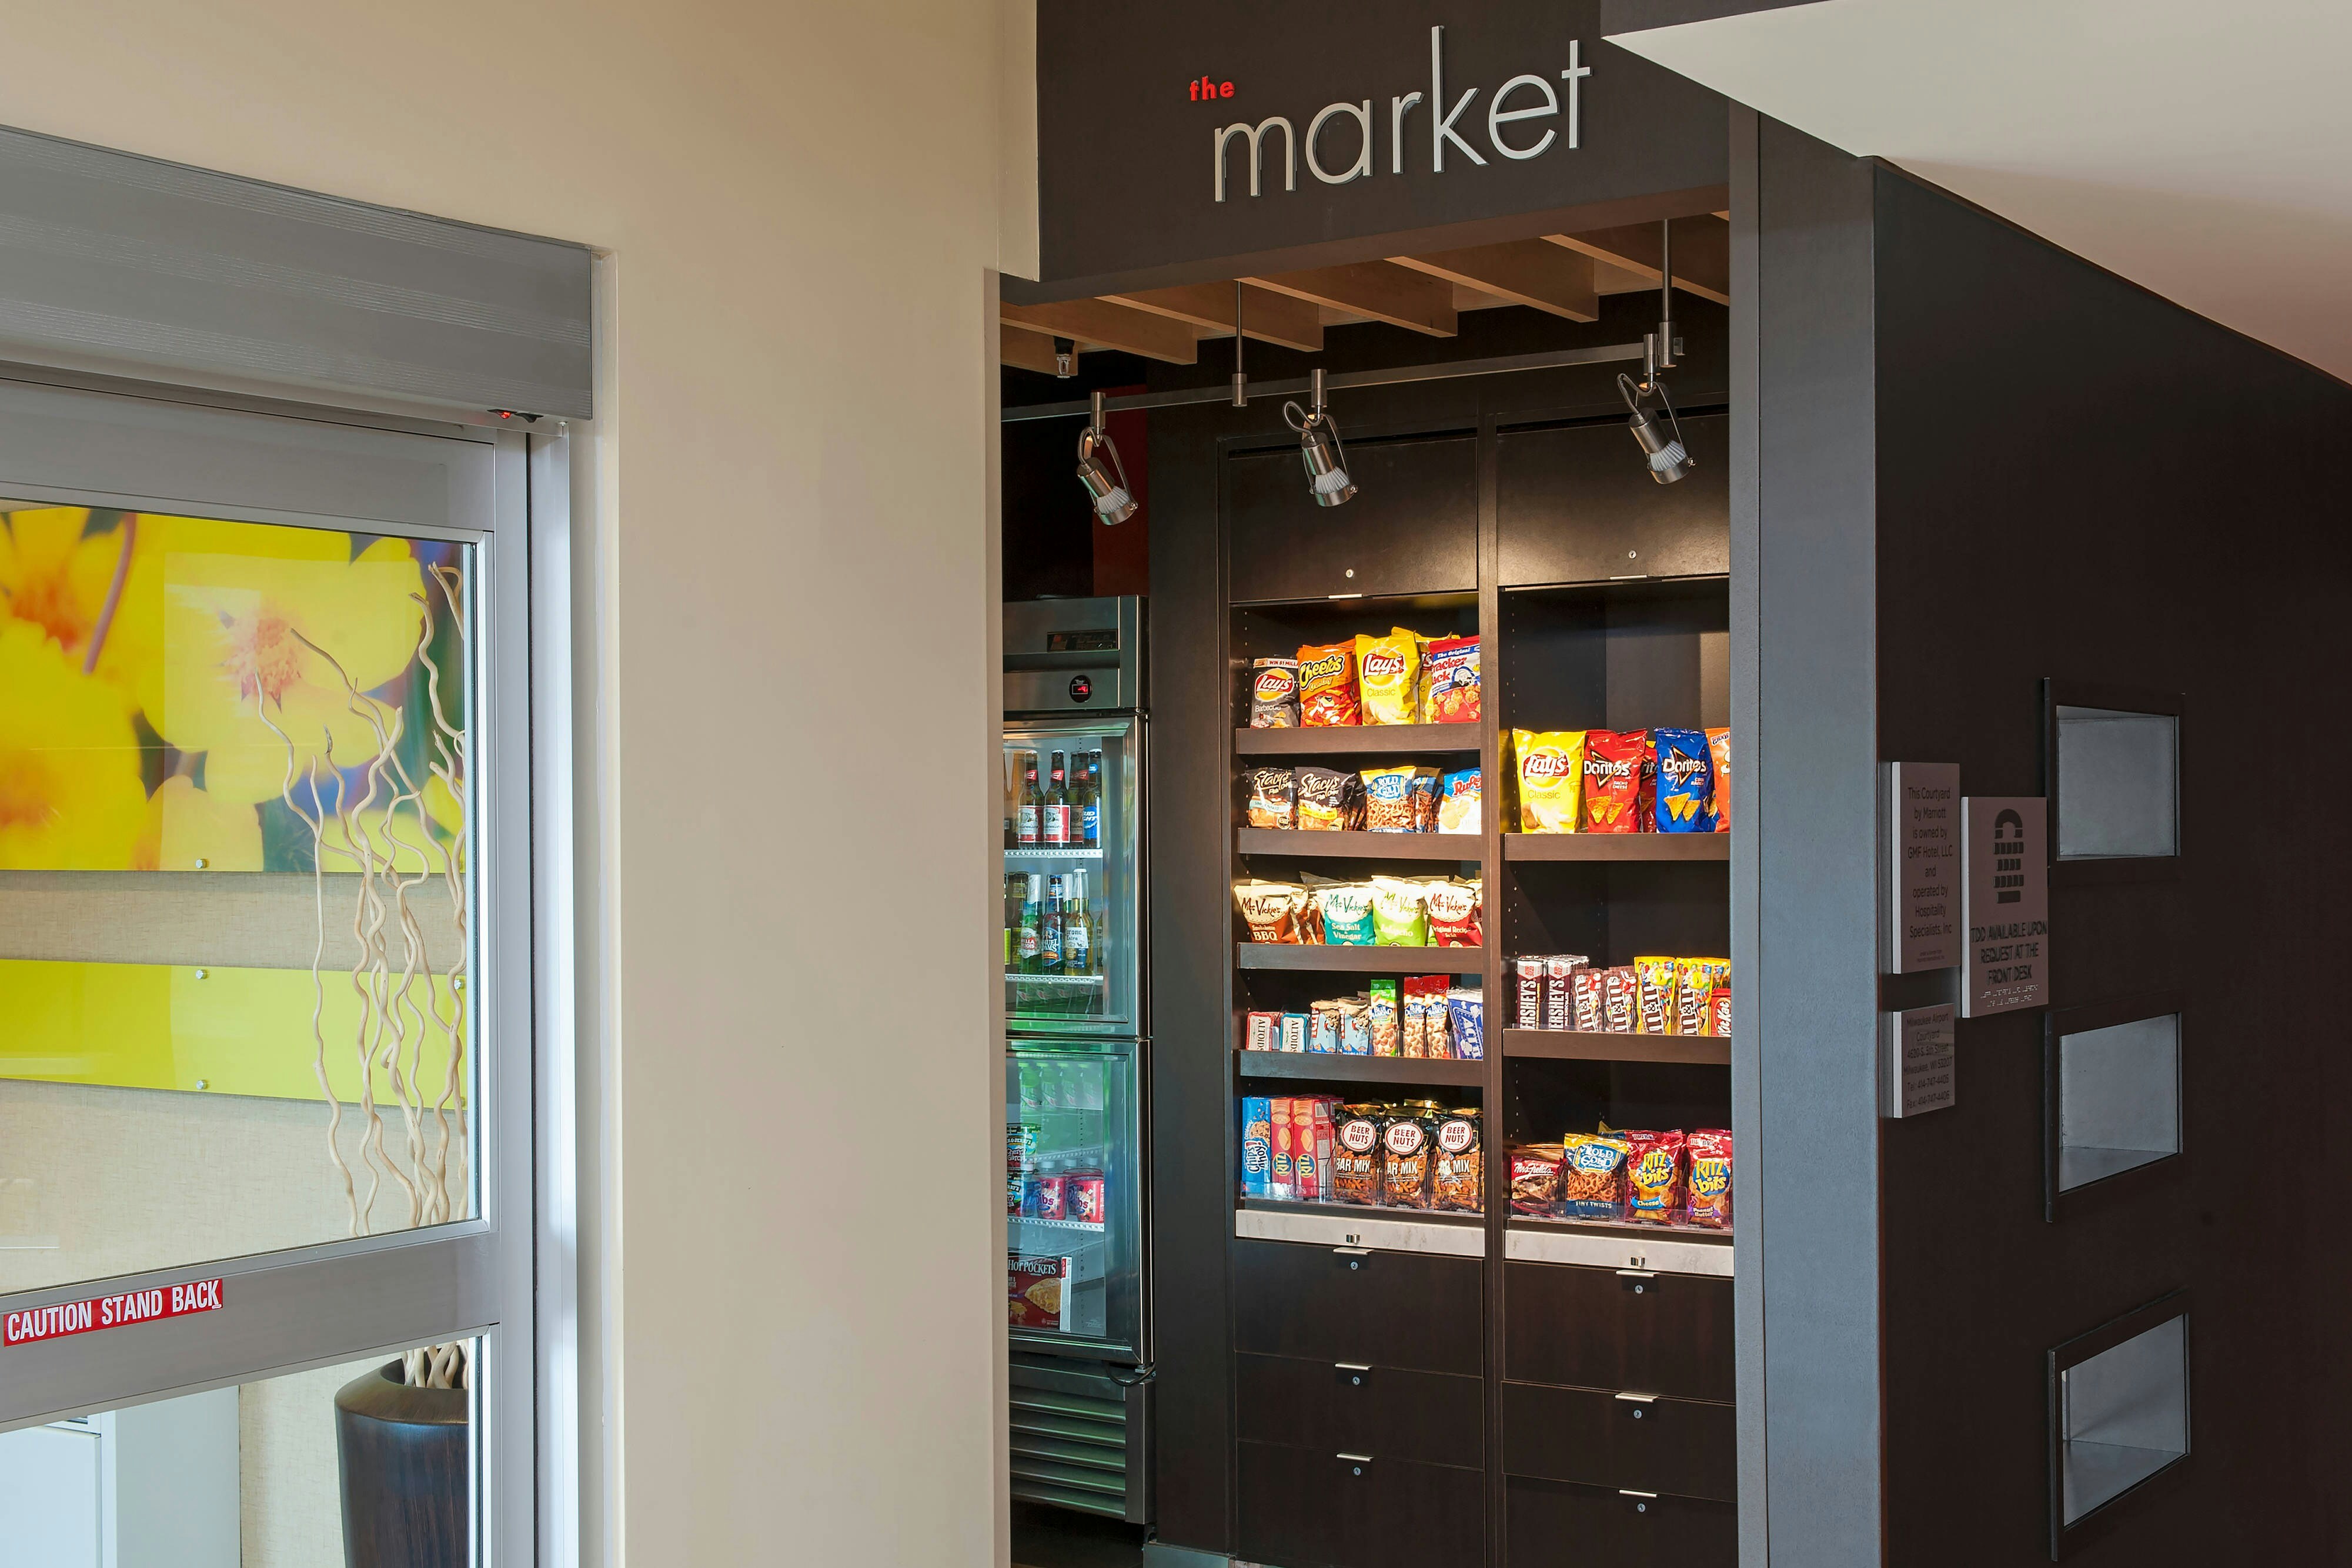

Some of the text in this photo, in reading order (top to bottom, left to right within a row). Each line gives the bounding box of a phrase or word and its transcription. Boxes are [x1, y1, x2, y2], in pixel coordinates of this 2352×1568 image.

[1189, 75, 1234, 101] the
[1214, 25, 1592, 203] market
[1448, 647, 1471, 657] Original
[1365, 654, 1403, 677] Lay's
[1432, 656, 1468, 673] racker
[1299, 656, 1344, 689] Cheetos
[1432, 671, 1451, 684] ack
[1257, 675, 1293, 692] Lay's
[1367, 687, 1396, 697] Classic
[1525, 755, 1566, 777] Lay's
[1583, 760, 1632, 776] Doritos
[1663, 758, 1707, 773] Doritos
[1298, 773, 1341, 797] Stacy's
[1378, 785, 1400, 796] GOLD
[1528, 790, 1561, 799] Classic
[1908, 787, 1950, 801] This Courtyard
[1914, 807, 1946, 822] by Marriott
[1913, 825, 1947, 840] is owned by
[1907, 846, 1922, 859] GMF
[1942, 844, 1953, 857] LLC
[1925, 865, 1936, 878] and
[1913, 884, 1948, 900] operated by
[1256, 898, 1281, 917] Vickie's
[1344, 895, 1368, 915] Vickie's
[1446, 895, 1467, 915] Vickie's
[1915, 903, 1946, 918] Hospitality
[1254, 931, 1278, 941] BBQ
[1333, 931, 1362, 940] Vinegar
[1988, 922, 2026, 940] AVAILABLE
[2027, 921, 2047, 937] UPON
[1980, 942, 2039, 964] REQUEST AT THE
[1987, 964, 2032, 985] FRONT DESK
[1520, 980, 1536, 1029] ERSHEY'S
[1549, 980, 1565, 1029] ERSHEY'S
[1907, 1013, 1949, 1027] Milwaukee Airport
[1258, 1019, 1266, 1051] ALTOIDS
[1291, 1021, 1299, 1052] ALTOIDS
[1462, 1017, 1478, 1044] ACT
[1916, 1029, 1940, 1042] Courtyard
[1351, 1125, 1370, 1135] BEER
[1394, 1128, 1416, 1138] BEER
[1349, 1134, 1369, 1145] NUTS
[1393, 1136, 1415, 1147] NUTS
[1445, 1134, 1464, 1144] NUTS
[1585, 1145, 1613, 1158] ROLD
[1247, 1146, 1261, 1173] Chips
[1276, 1154, 1288, 1175] RITZ
[1299, 1156, 1312, 1178] RITZ
[1354, 1159, 1371, 1173] MIX
[1453, 1159, 1470, 1174] MIX
[1581, 1155, 1612, 1167] GOLD
[1642, 1151, 1667, 1172] RITZ
[1387, 1161, 1418, 1175] AR MIX
[1525, 1162, 1553, 1176] Fields
[1696, 1160, 1724, 1179] RITZ
[1642, 1167, 1670, 1185] bits
[1696, 1176, 1726, 1193] bits
[1078, 1197, 1089, 1209] bs
[1023, 1261, 1057, 1275] POCKETS
[8, 1279, 219, 1342] CAUTION STAND BACK
